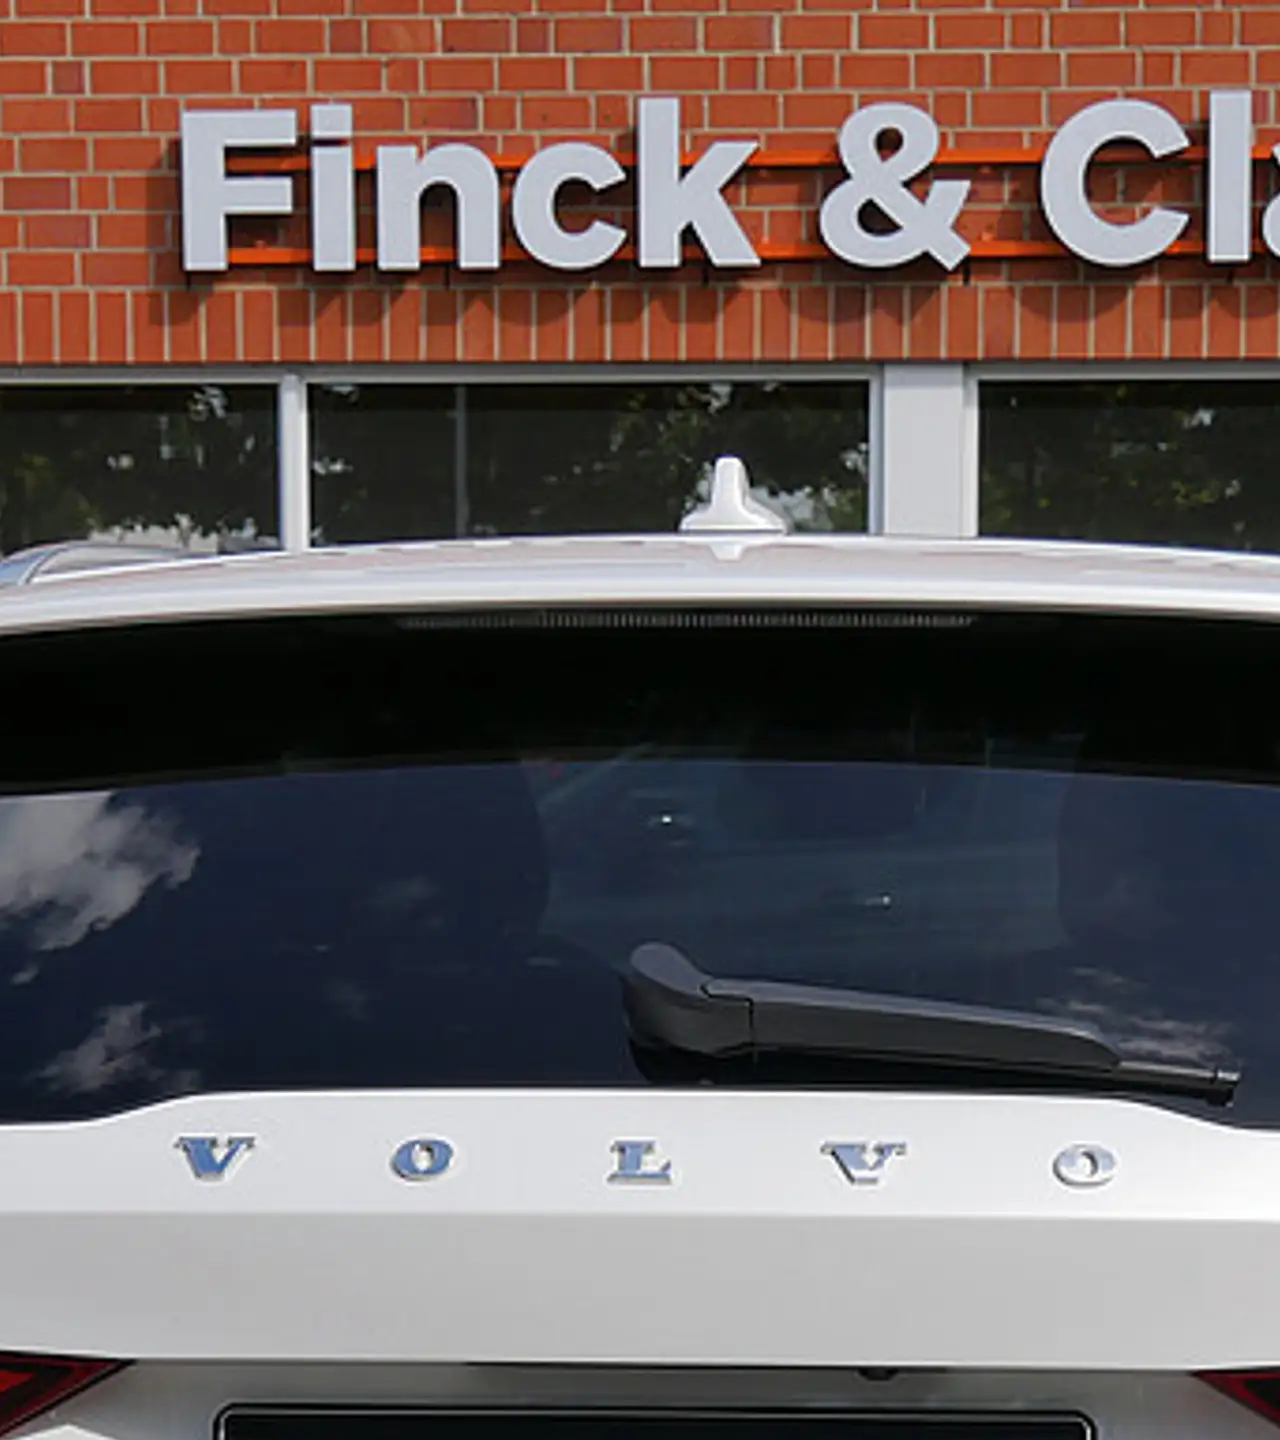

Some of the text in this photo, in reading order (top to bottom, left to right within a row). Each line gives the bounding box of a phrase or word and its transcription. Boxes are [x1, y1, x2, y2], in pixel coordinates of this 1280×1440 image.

[181, 94, 762, 272] Finck
[817, 101, 974, 274] &
[172, 1134, 1119, 1188] VOLVO
